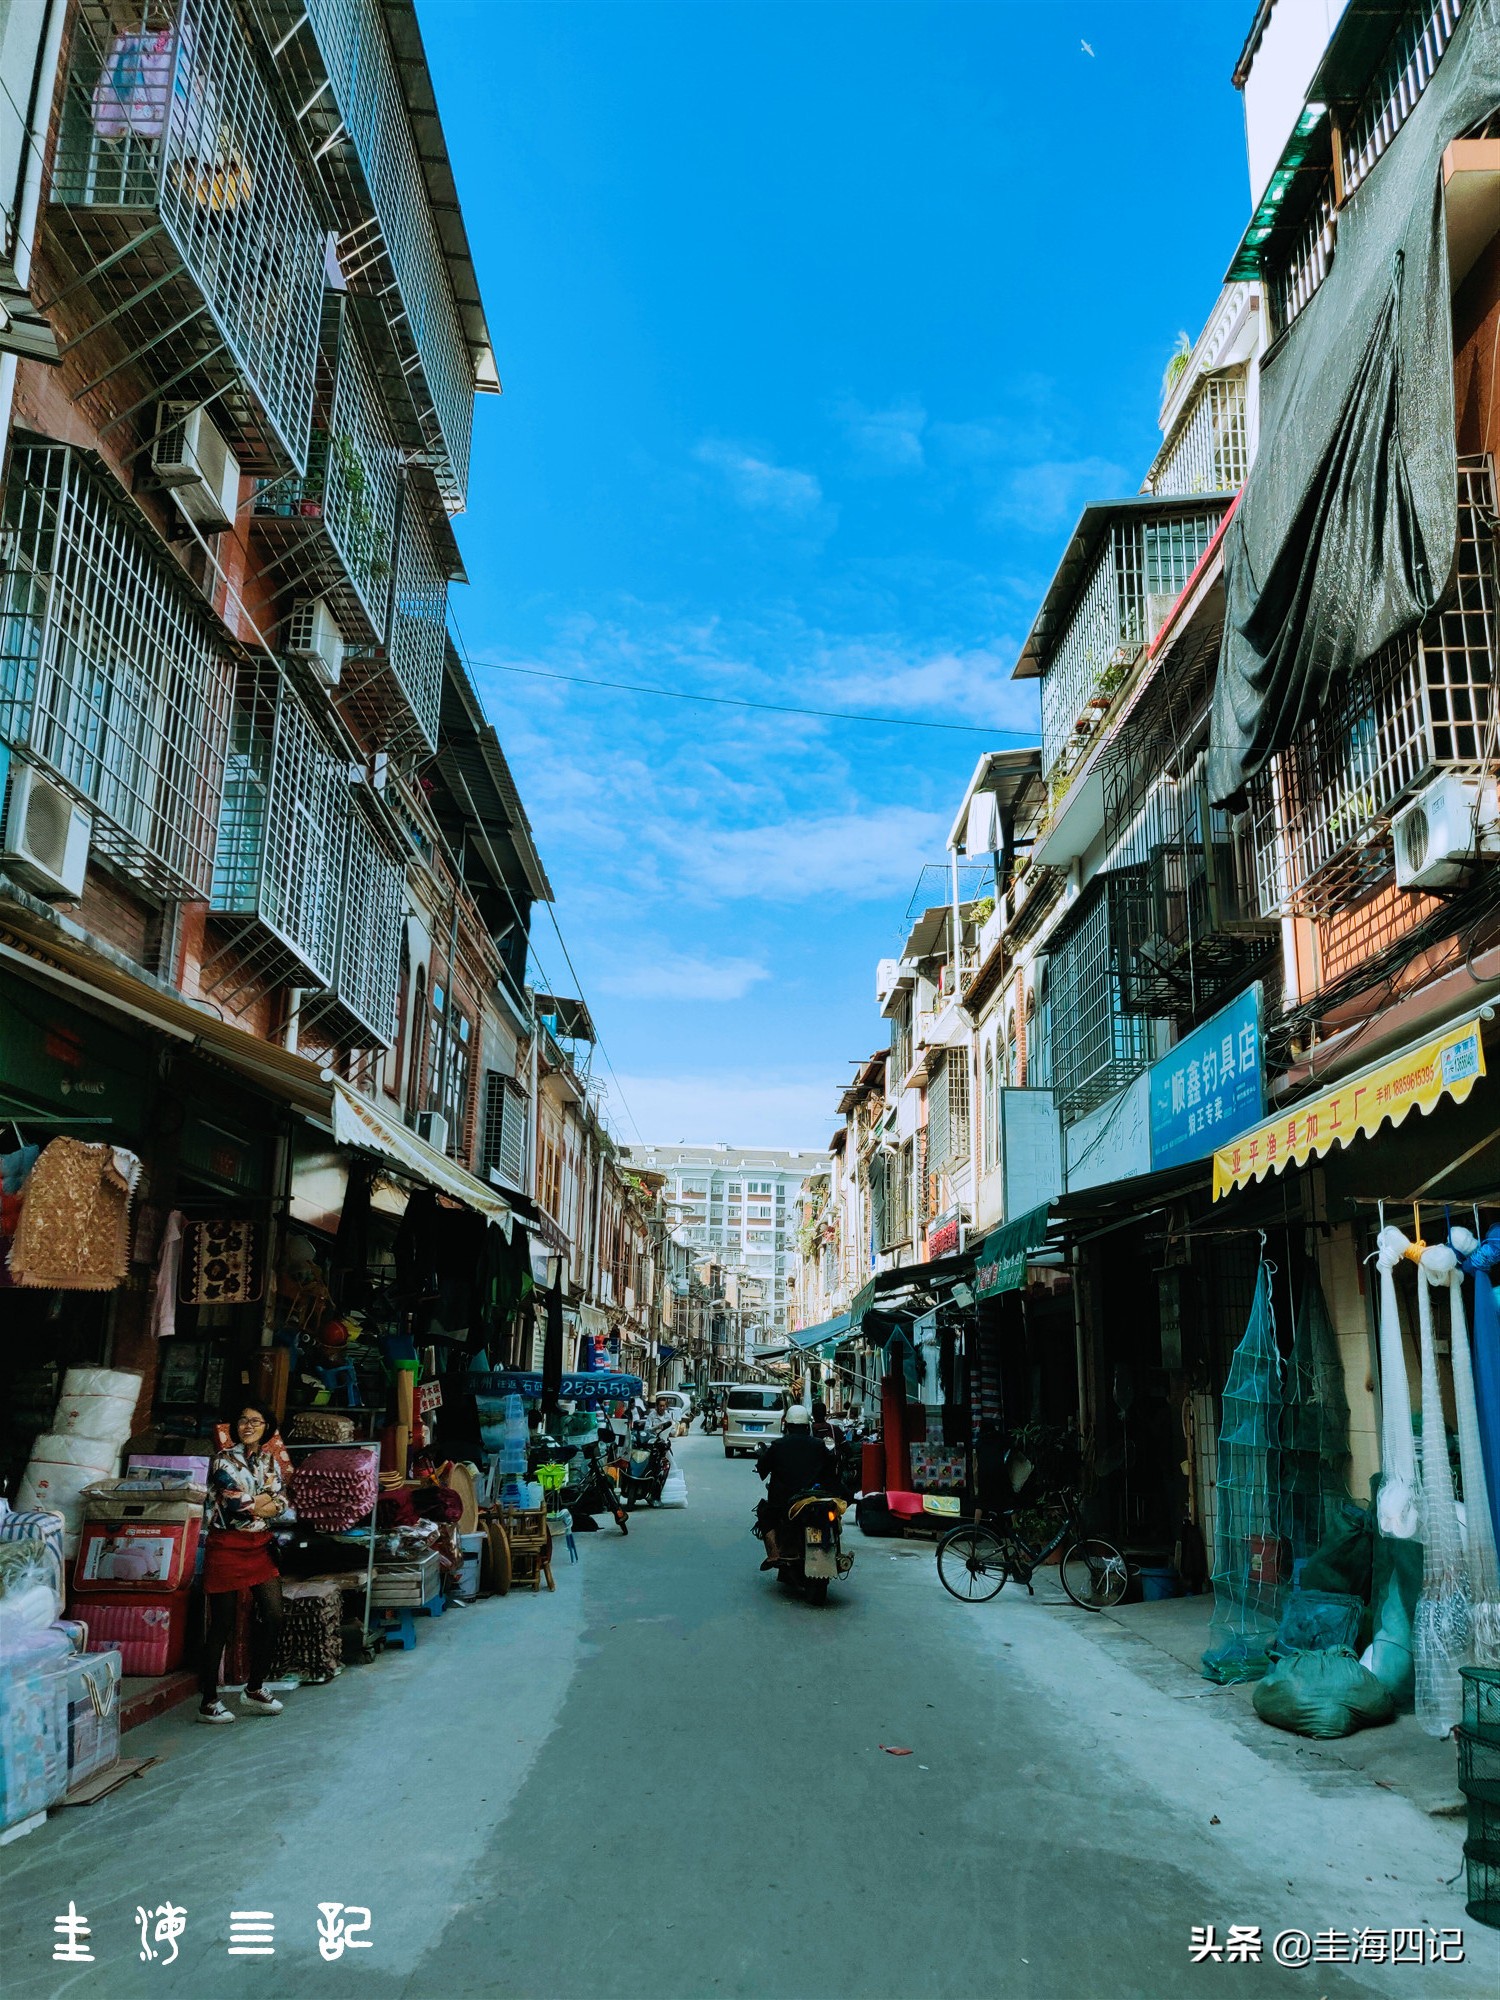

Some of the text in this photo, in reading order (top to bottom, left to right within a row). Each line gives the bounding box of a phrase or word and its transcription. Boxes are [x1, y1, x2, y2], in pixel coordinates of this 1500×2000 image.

[1172, 1021, 1255, 1115] 顺鑫钓具店
[1231, 1087, 1367, 1175] 亚平渔具加工厂
[1376, 1082, 1392, 1105] 手机
